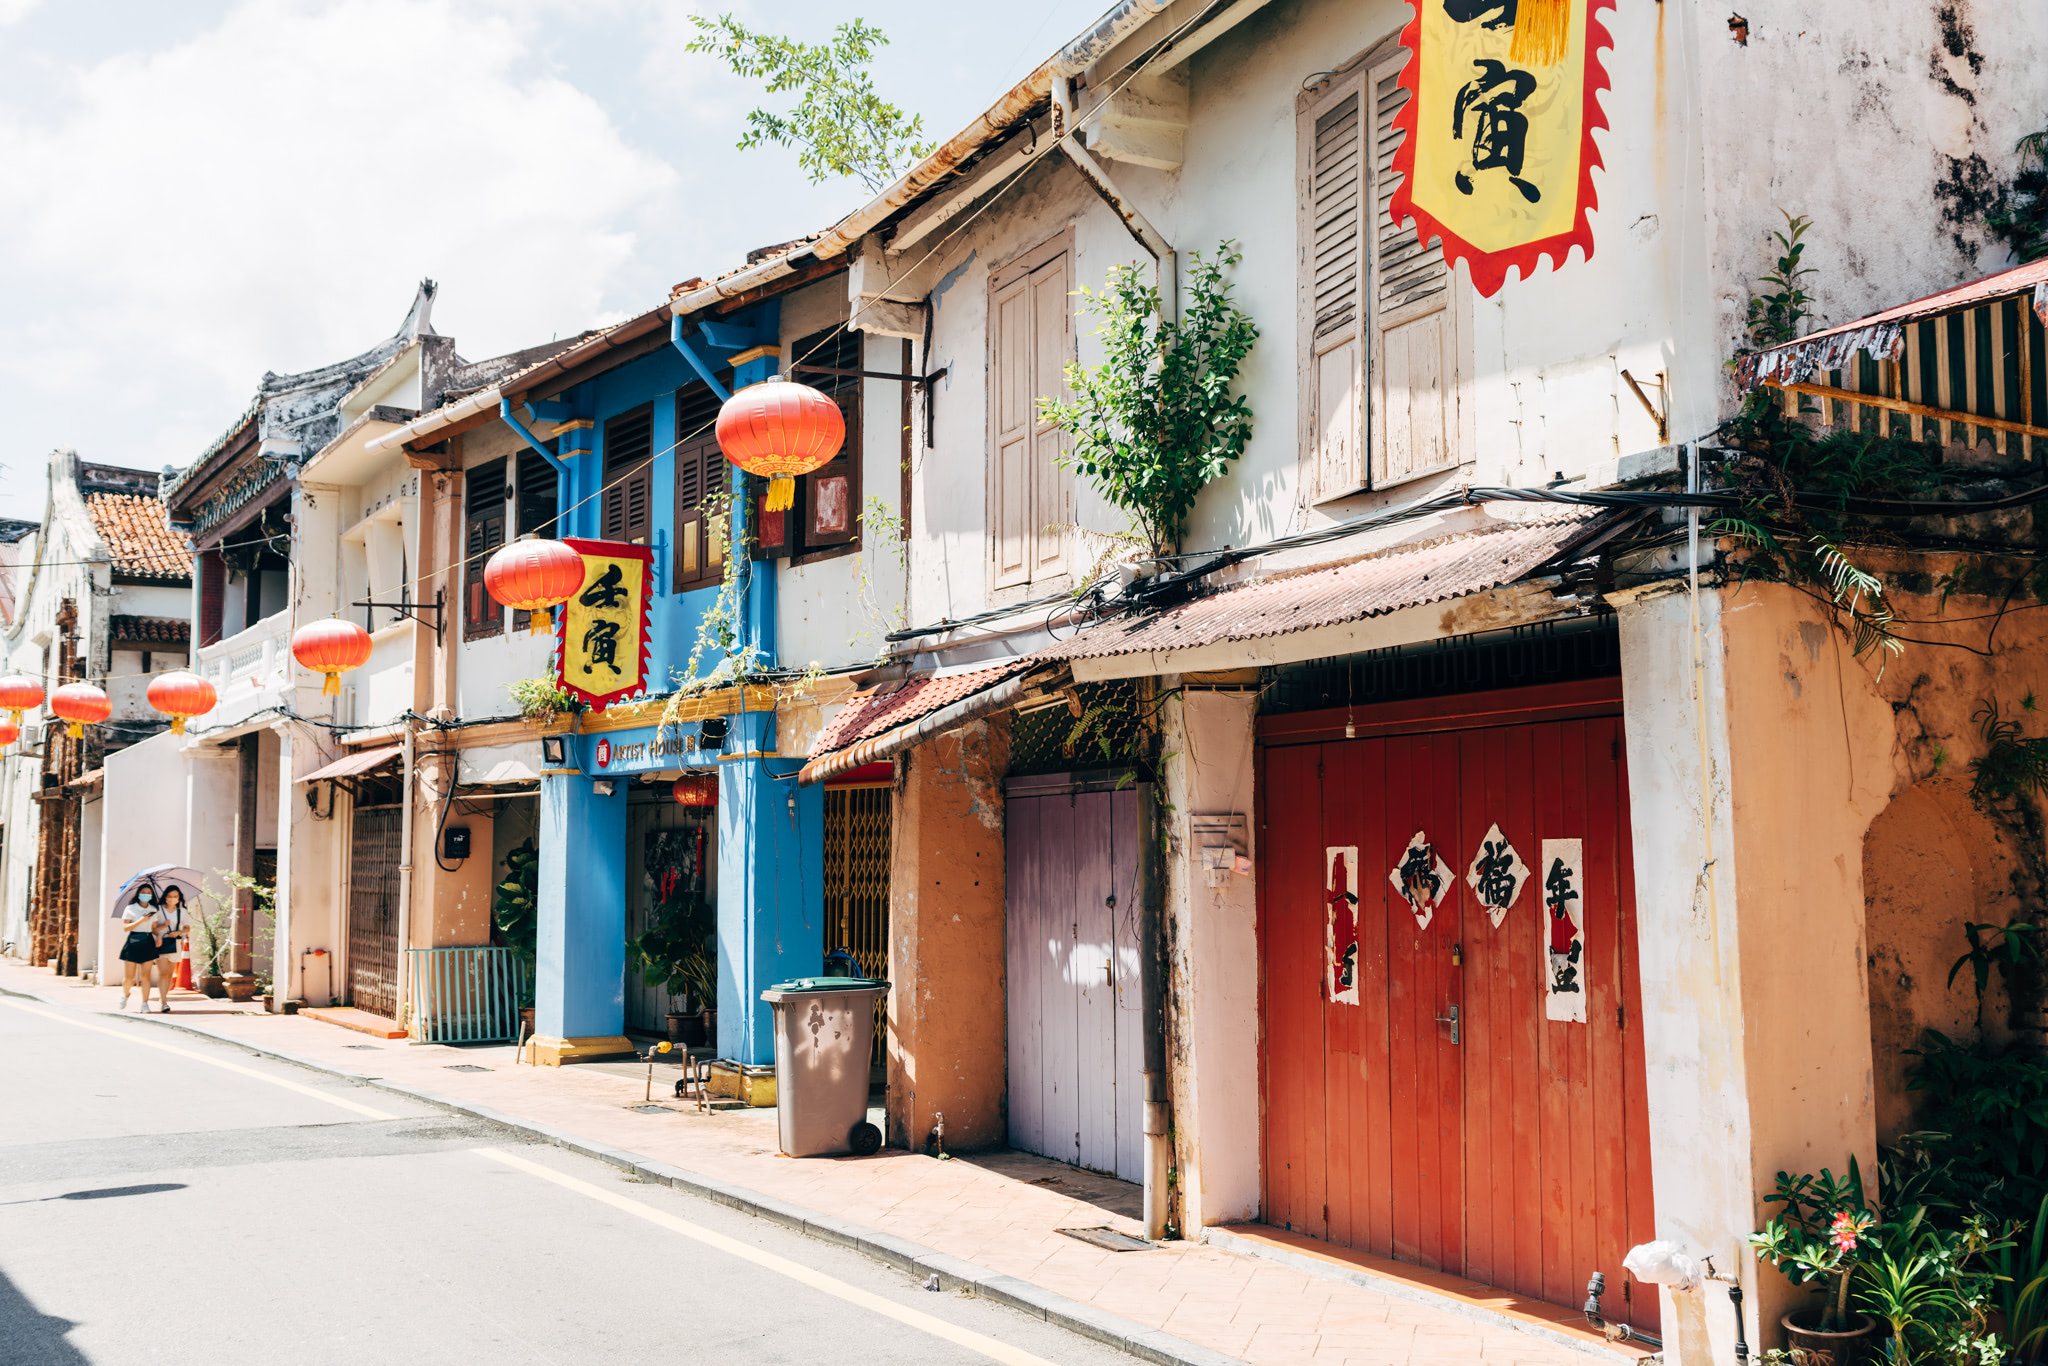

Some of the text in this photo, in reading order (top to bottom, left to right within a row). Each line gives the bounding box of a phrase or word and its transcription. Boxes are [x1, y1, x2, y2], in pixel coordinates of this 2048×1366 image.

[579, 564, 628, 674] 壬寅
[612, 743, 645, 760] ARTIST
[649, 739, 684, 757] HOUSE
[1476, 839, 1516, 908] 福
